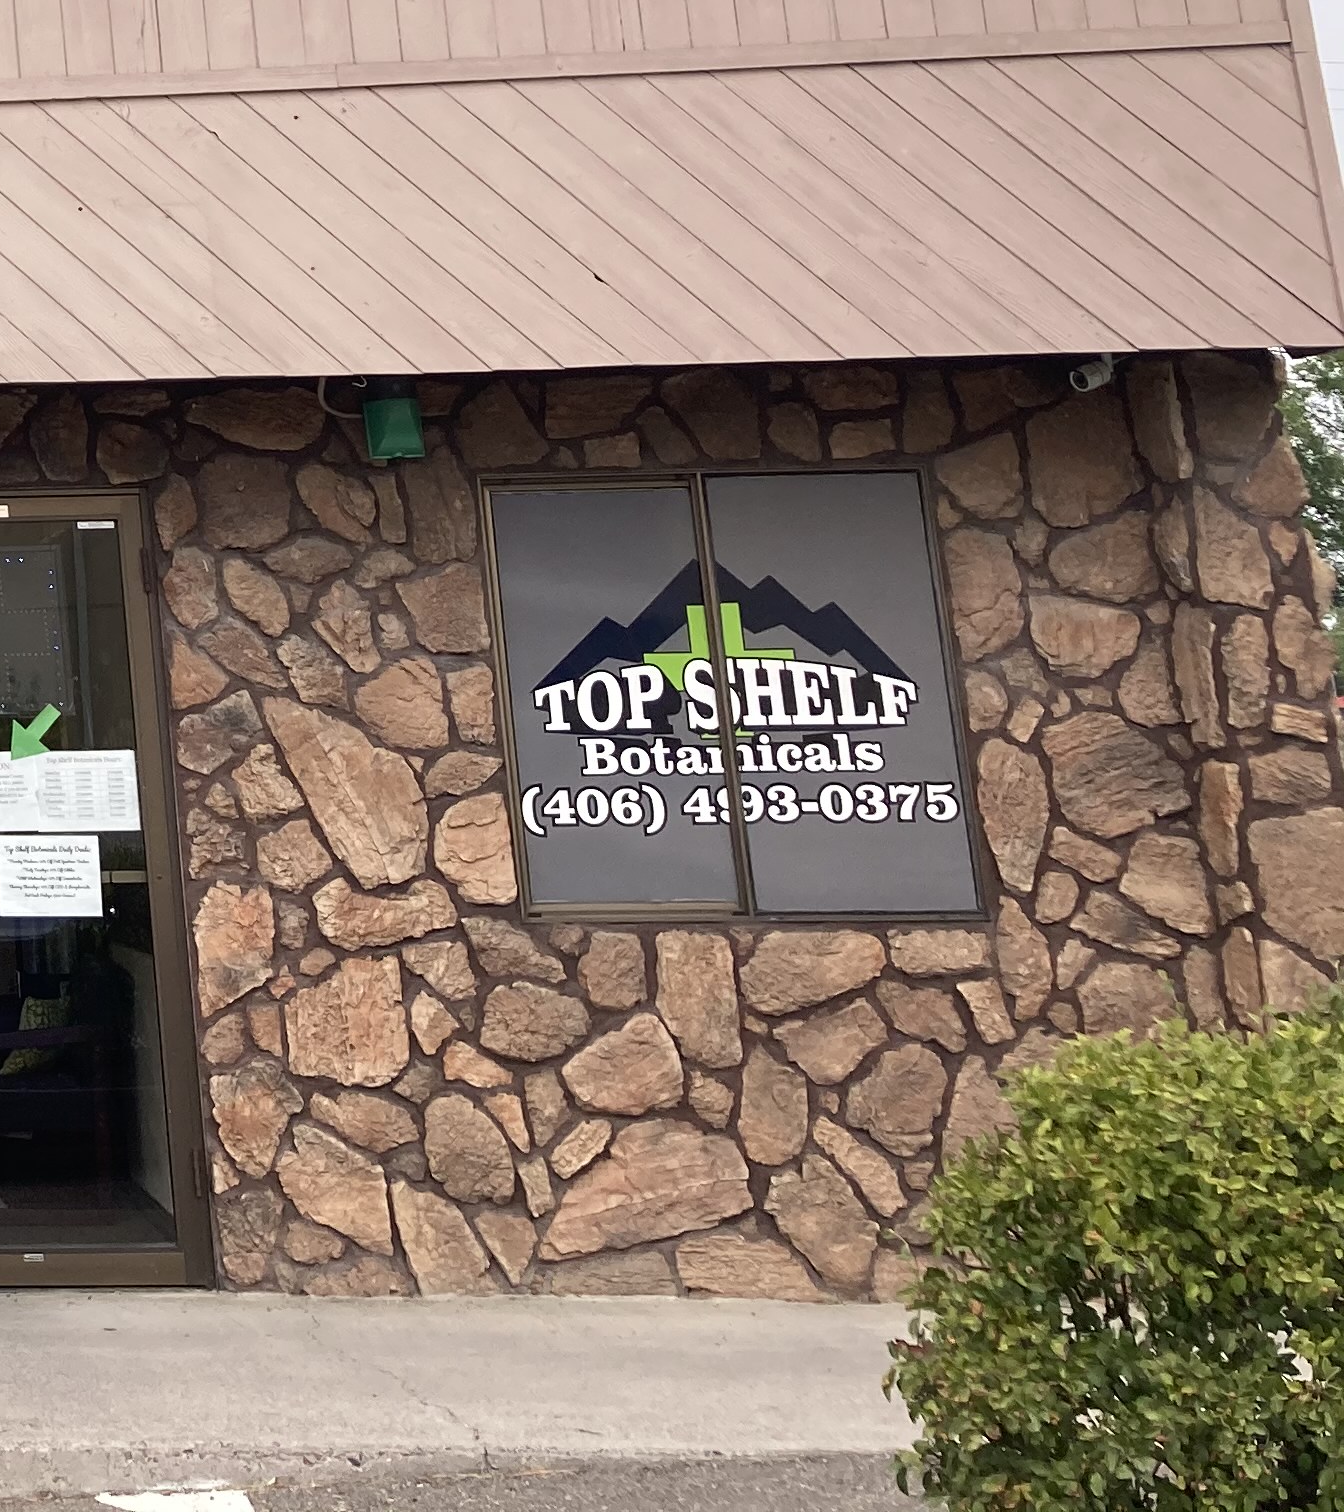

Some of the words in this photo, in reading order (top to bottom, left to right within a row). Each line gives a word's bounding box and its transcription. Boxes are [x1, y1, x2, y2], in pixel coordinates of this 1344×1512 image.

[534, 663, 666, 733] TOP
[682, 657, 919, 731] SHELF
[578, 733, 885, 777] Botanicals
[520, 783, 666, 836] (406)
[682, 782, 960, 824] 493-0375
